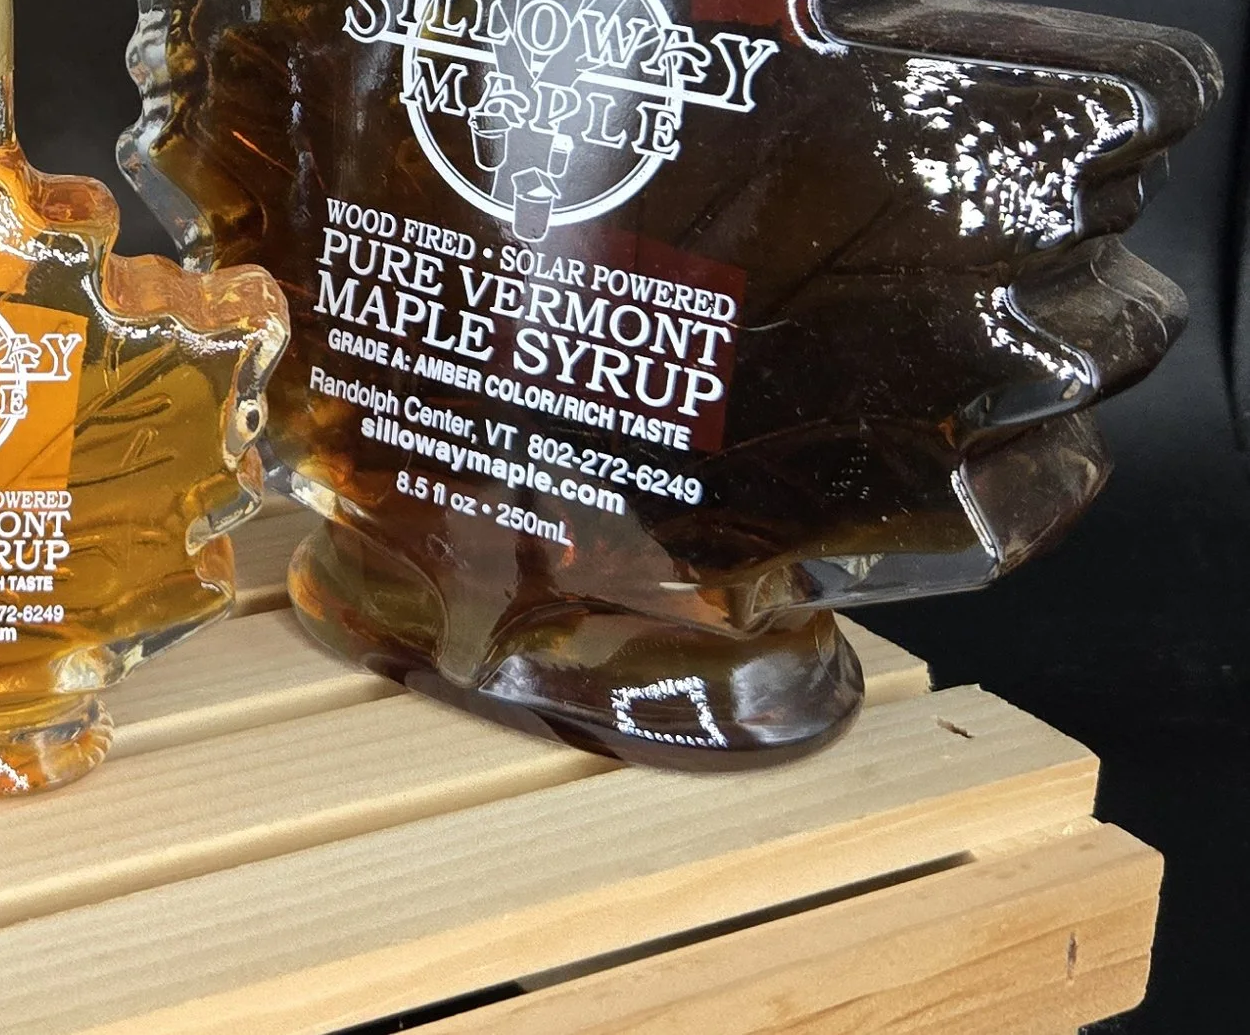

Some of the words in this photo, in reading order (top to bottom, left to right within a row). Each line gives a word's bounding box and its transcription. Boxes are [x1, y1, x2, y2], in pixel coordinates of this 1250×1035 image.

[401, 58, 683, 161] MAPLE
[316, 229, 444, 295] PURE
[459, 265, 731, 366] VERMONT
[327, 199, 396, 239] WOOD
[403, 217, 476, 261] FIRED
[500, 246, 585, 287] SOLAR
[593, 265, 737, 321] POWERED
[314, 271, 494, 362] MAPLE
[513, 332, 724, 417] SYRUP
[327, 328, 388, 365] GRADE
[391, 346, 411, 370] A:
[415, 353, 481, 392] AMBER
[485, 374, 615, 430] COLOR/RICH
[619, 413, 691, 451] TASTE
[310, 366, 399, 417] Randolph
[404, 395, 478, 443] Center,
[484, 422, 518, 452] VT
[527, 434, 703, 505] 802-272-6249
[360, 414, 625, 516] sillowaymaple.com
[396, 470, 429, 498] 8.5
[433, 482, 445, 504] fl
[450, 493, 476, 515] oz
[497, 506, 572, 546] 250mL
[8, 576, 53, 591] TASTE
